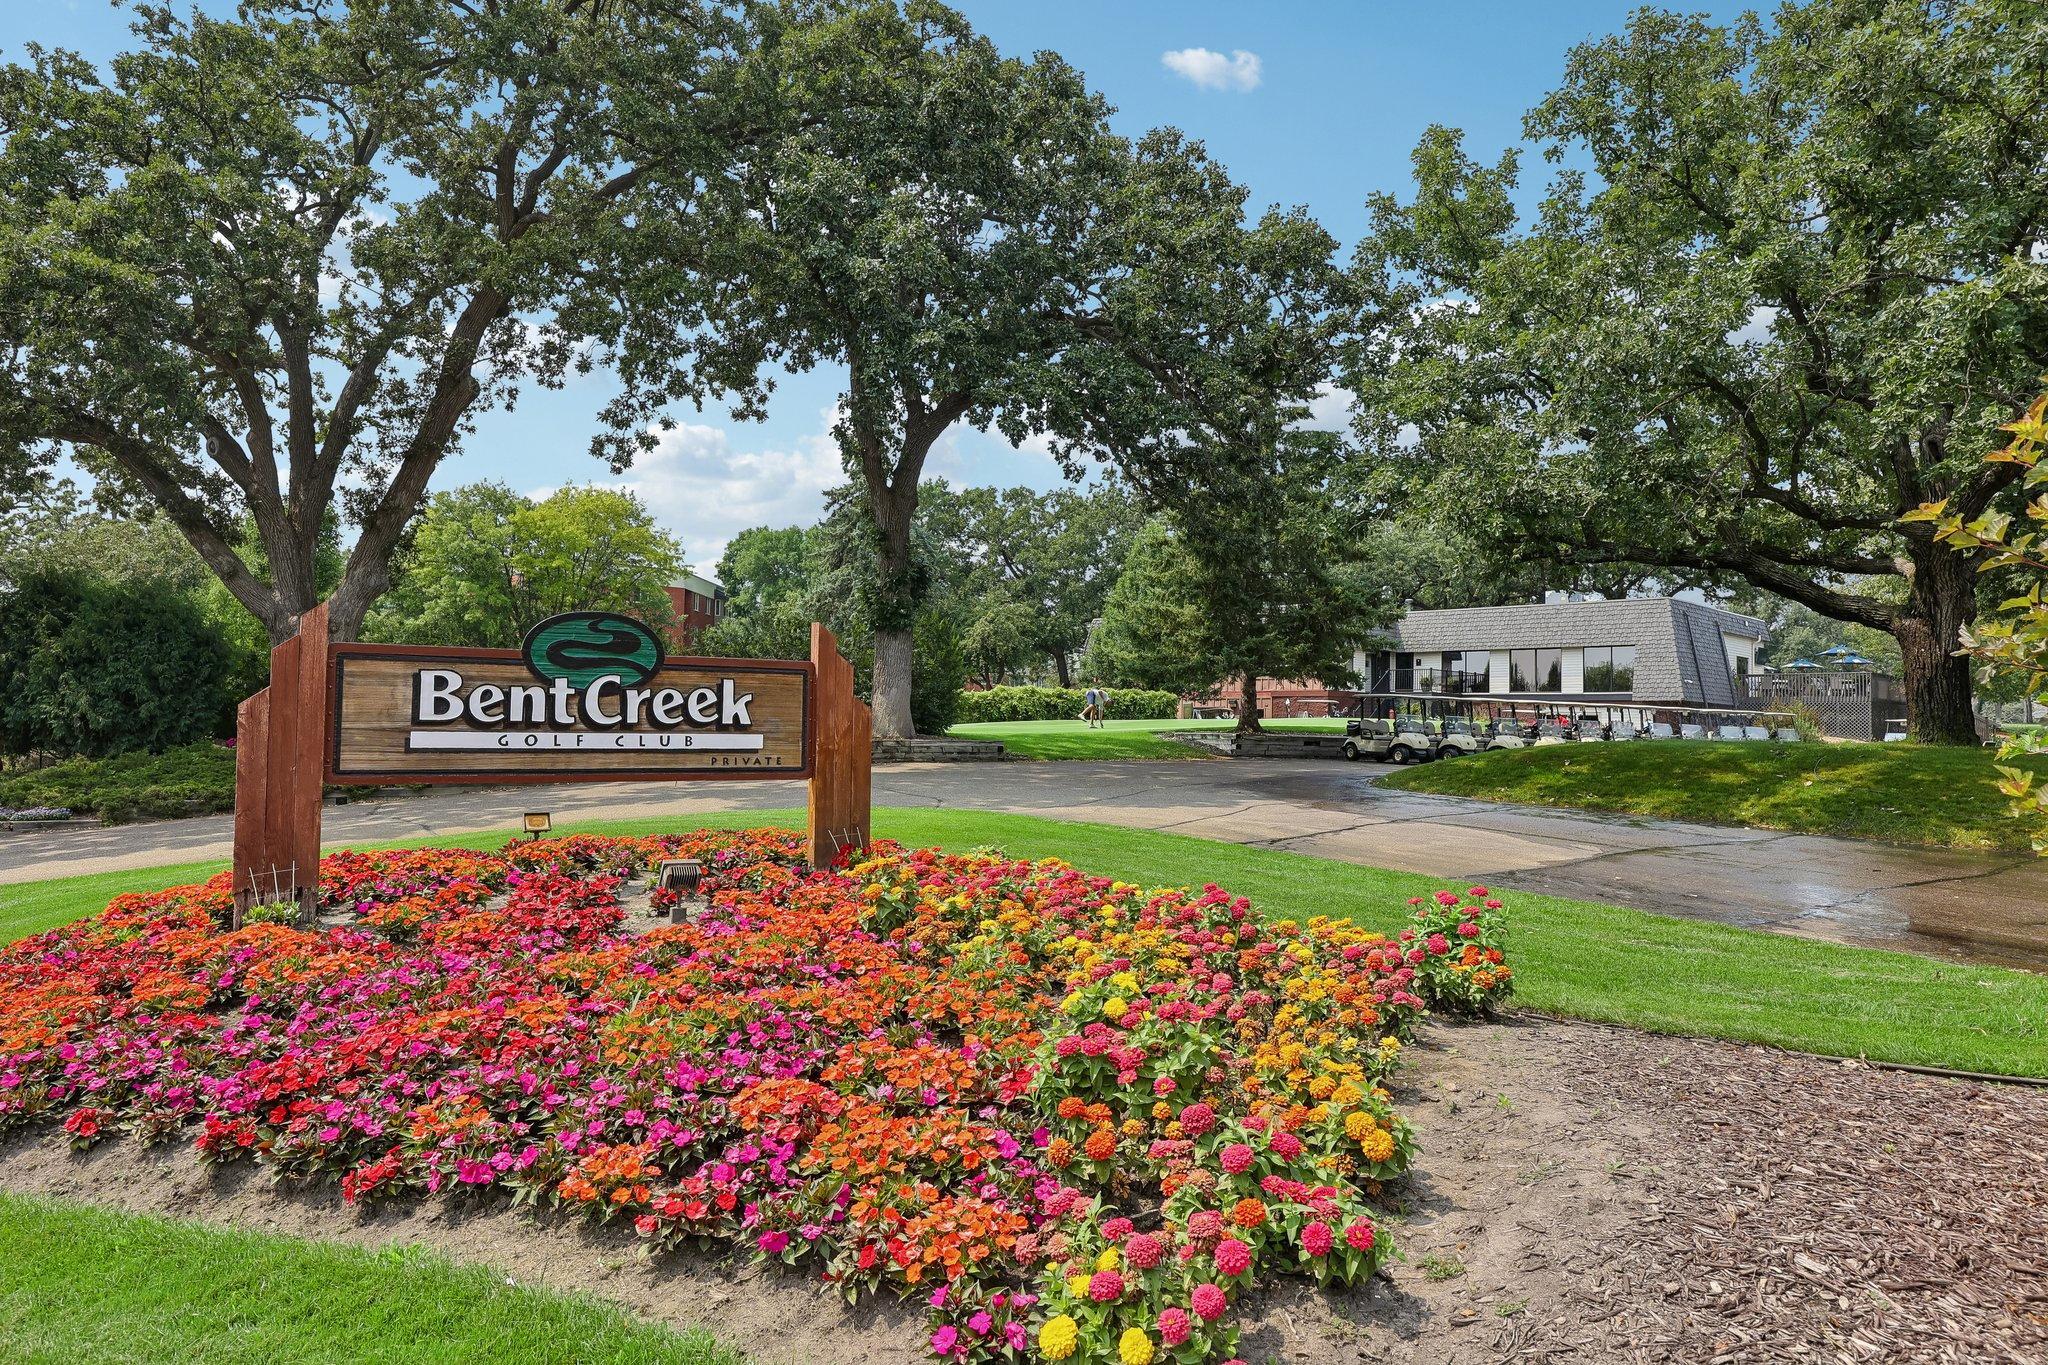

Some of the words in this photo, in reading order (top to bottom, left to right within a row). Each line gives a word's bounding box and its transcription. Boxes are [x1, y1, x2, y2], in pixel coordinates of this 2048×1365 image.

[418, 669, 576, 725] Bent
[584, 674, 753, 726] Creek
[497, 734, 584, 747] GOLF
[614, 734, 694, 748] CLUB
[710, 756, 783, 766] PRIVATE
